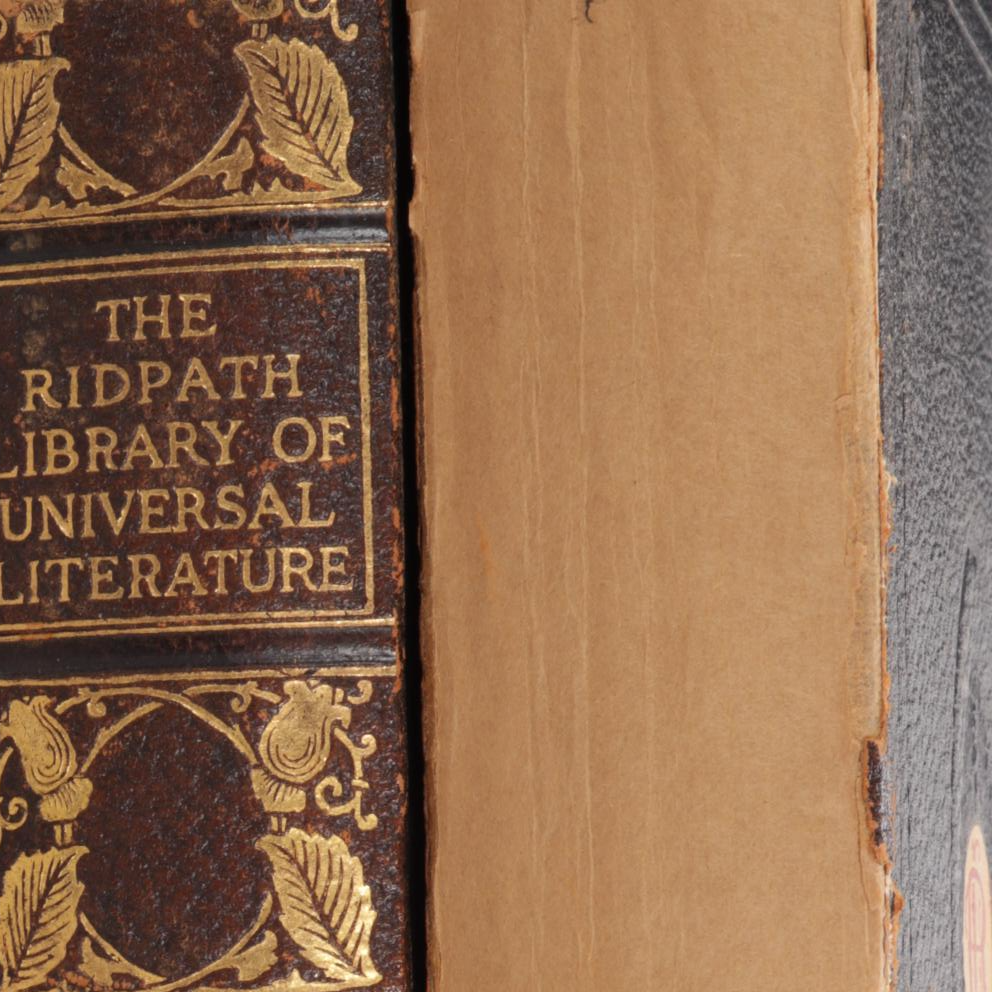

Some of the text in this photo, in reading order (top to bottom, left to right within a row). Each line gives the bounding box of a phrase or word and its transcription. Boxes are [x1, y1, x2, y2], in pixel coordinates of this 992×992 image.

[96, 293, 217, 342] THE
[21, 354, 304, 412] RIDPATH
[272, 416, 350, 463] OF
